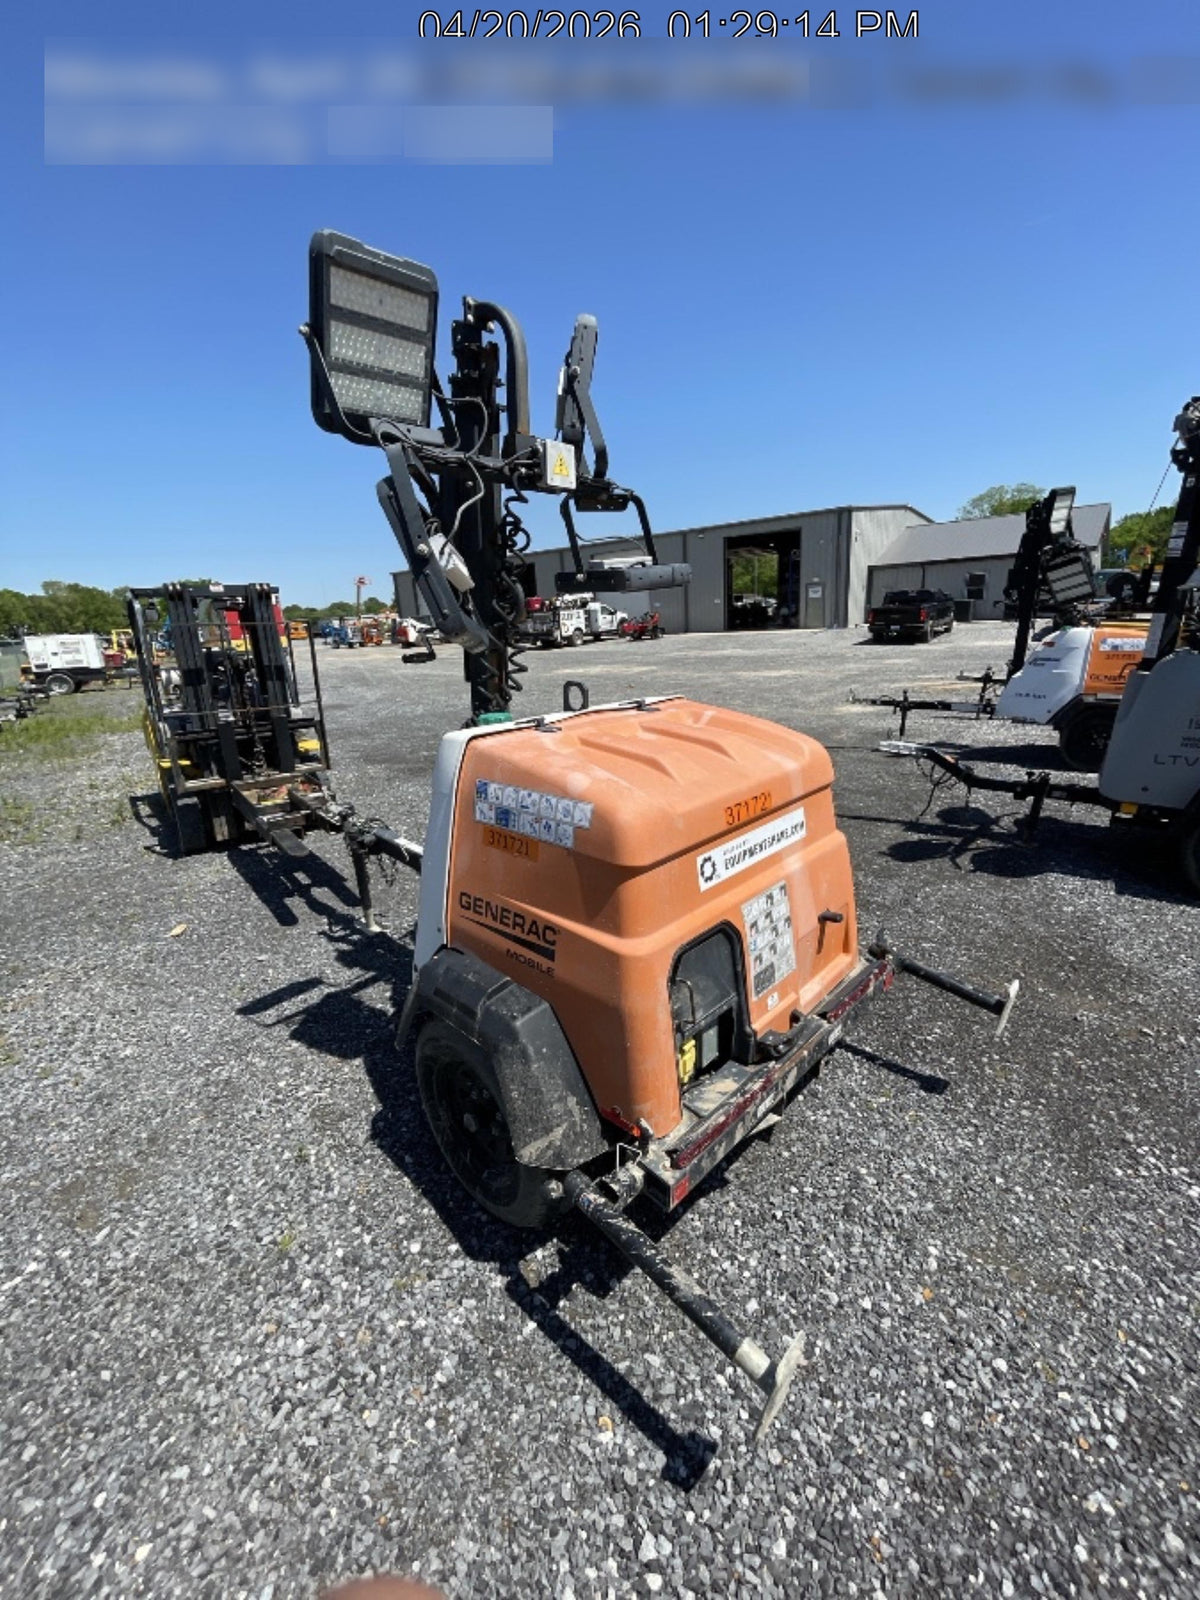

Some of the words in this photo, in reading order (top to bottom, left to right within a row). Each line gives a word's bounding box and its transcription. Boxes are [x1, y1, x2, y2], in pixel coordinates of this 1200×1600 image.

[725, 791, 772, 826] 371721
[488, 830, 529, 856] 371721
[459, 891, 557, 946] GENERAC
[506, 948, 555, 977] MOBILE
